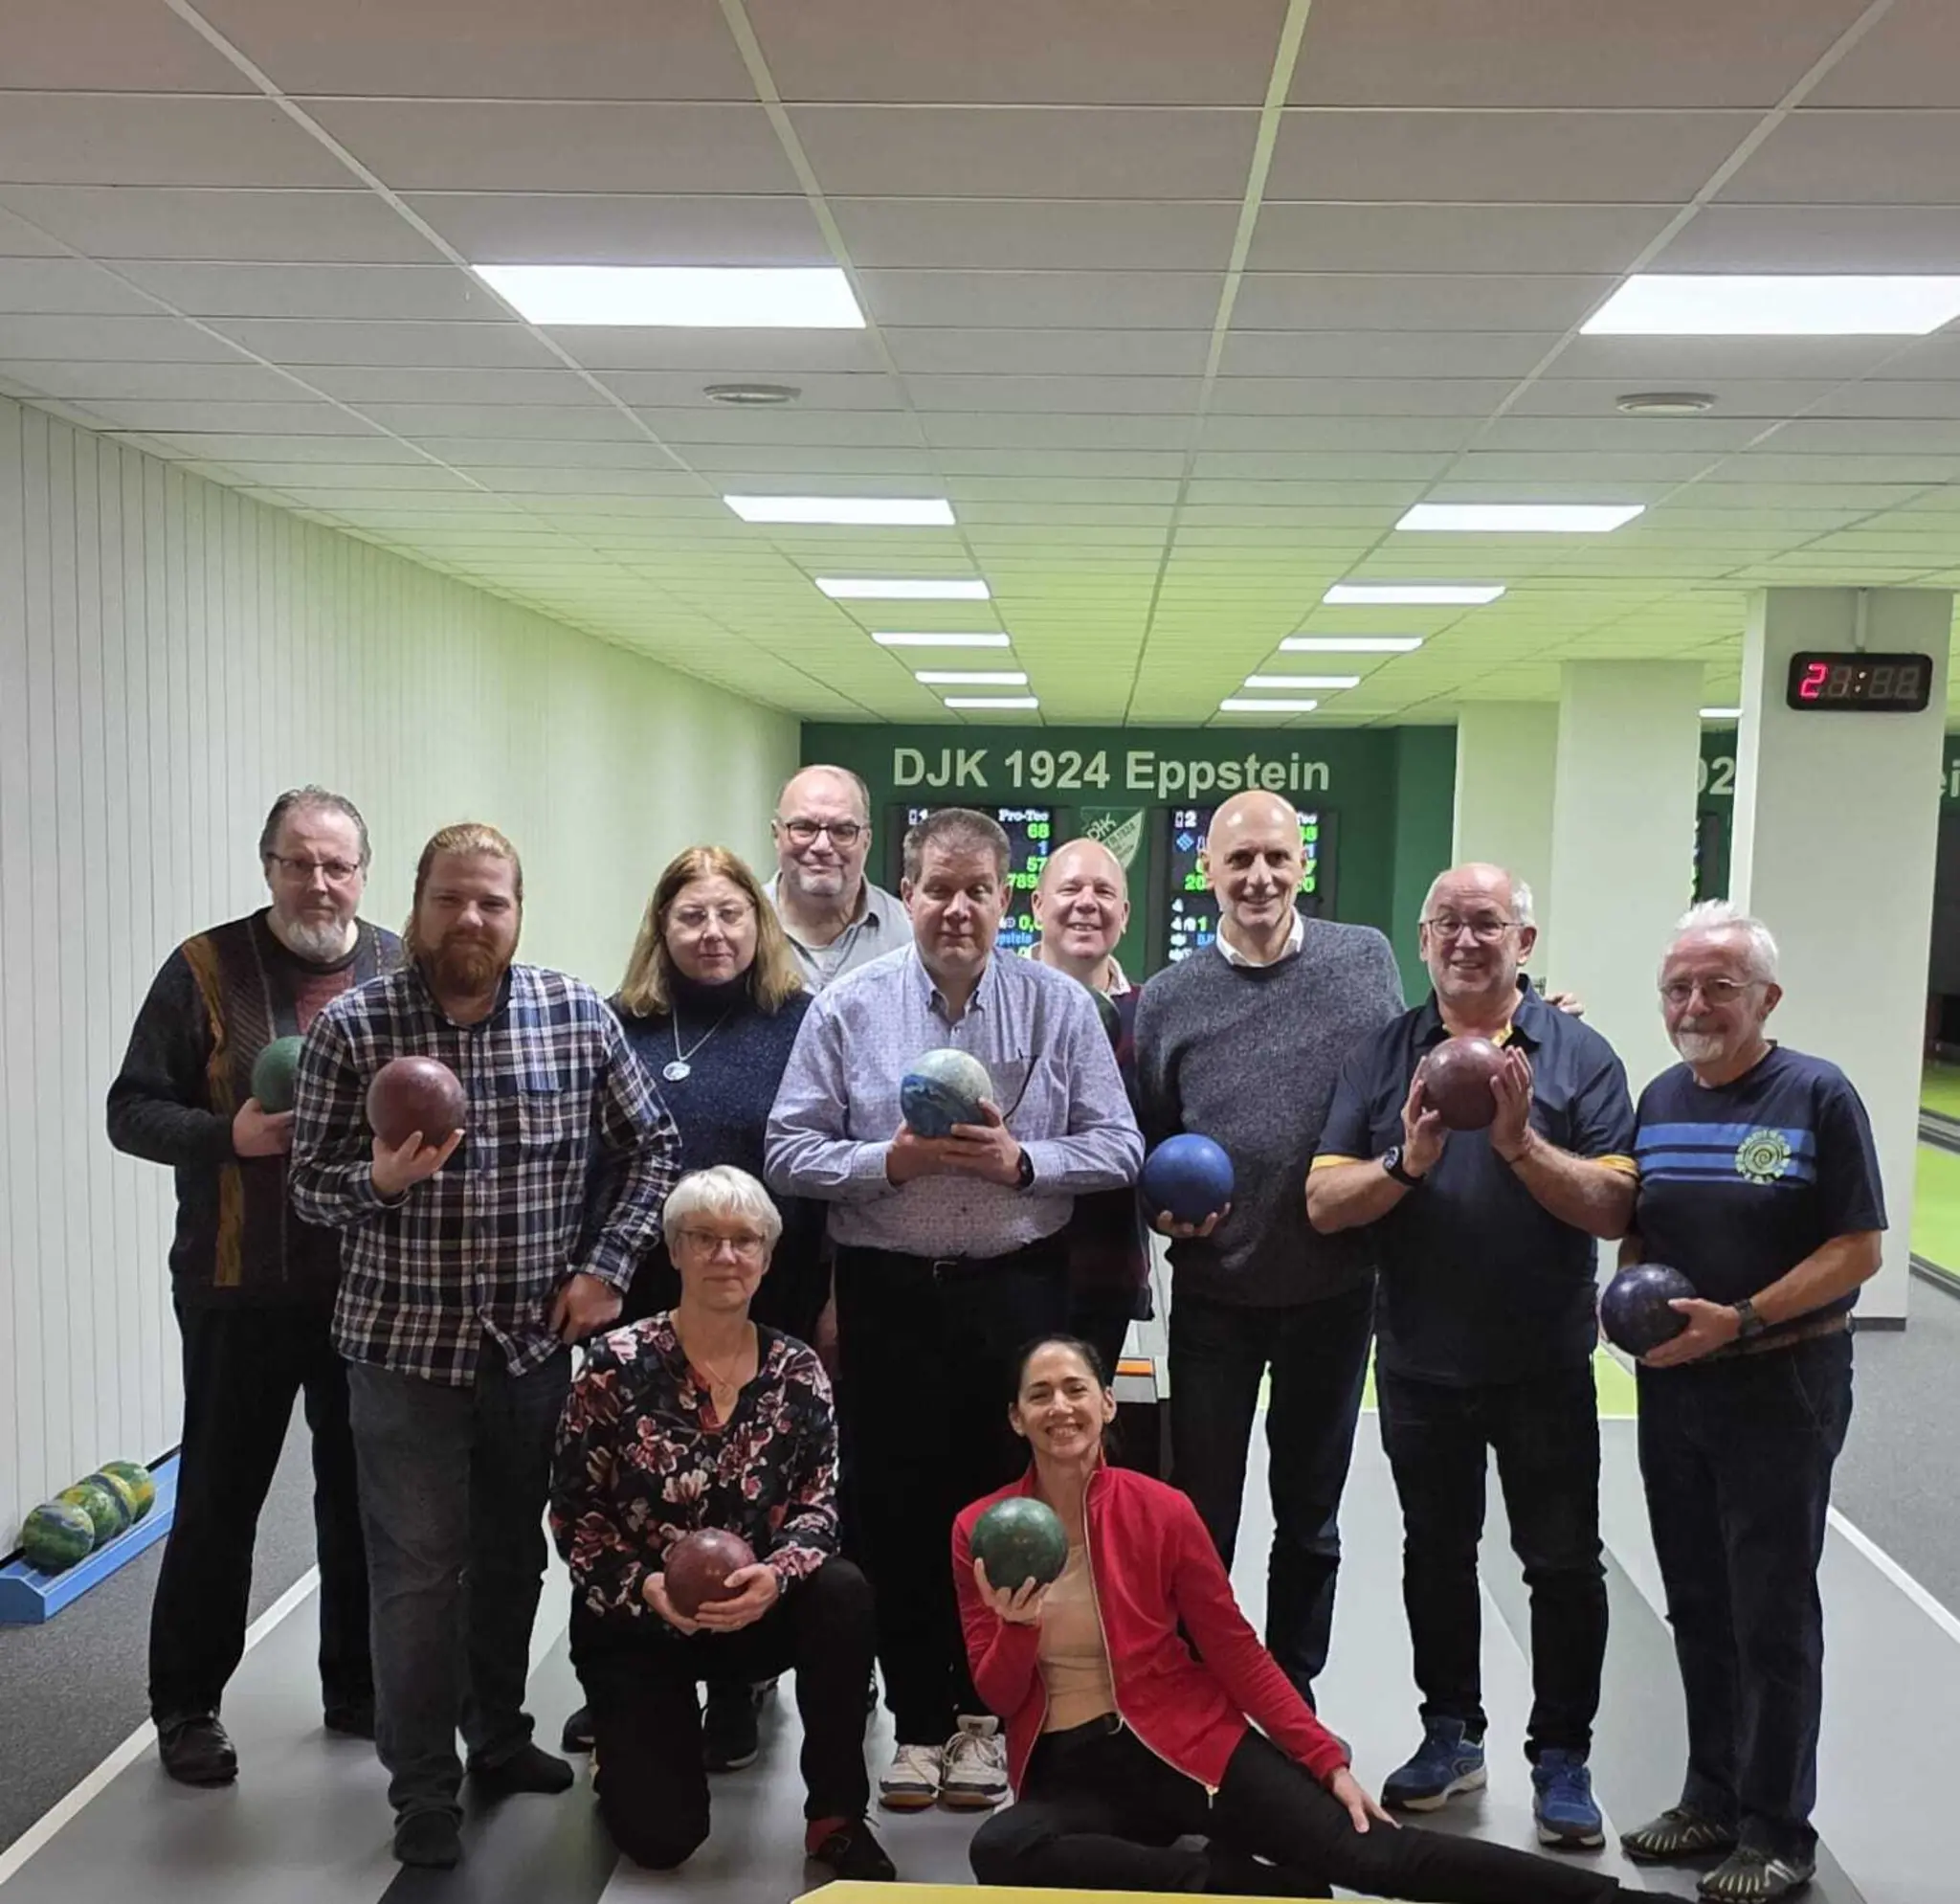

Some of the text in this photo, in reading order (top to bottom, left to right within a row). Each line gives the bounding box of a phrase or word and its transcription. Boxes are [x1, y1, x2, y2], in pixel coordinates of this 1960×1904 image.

[893, 748, 1329, 799] DJK 1924 Eppstein
[1006, 873, 1039, 889] 789
